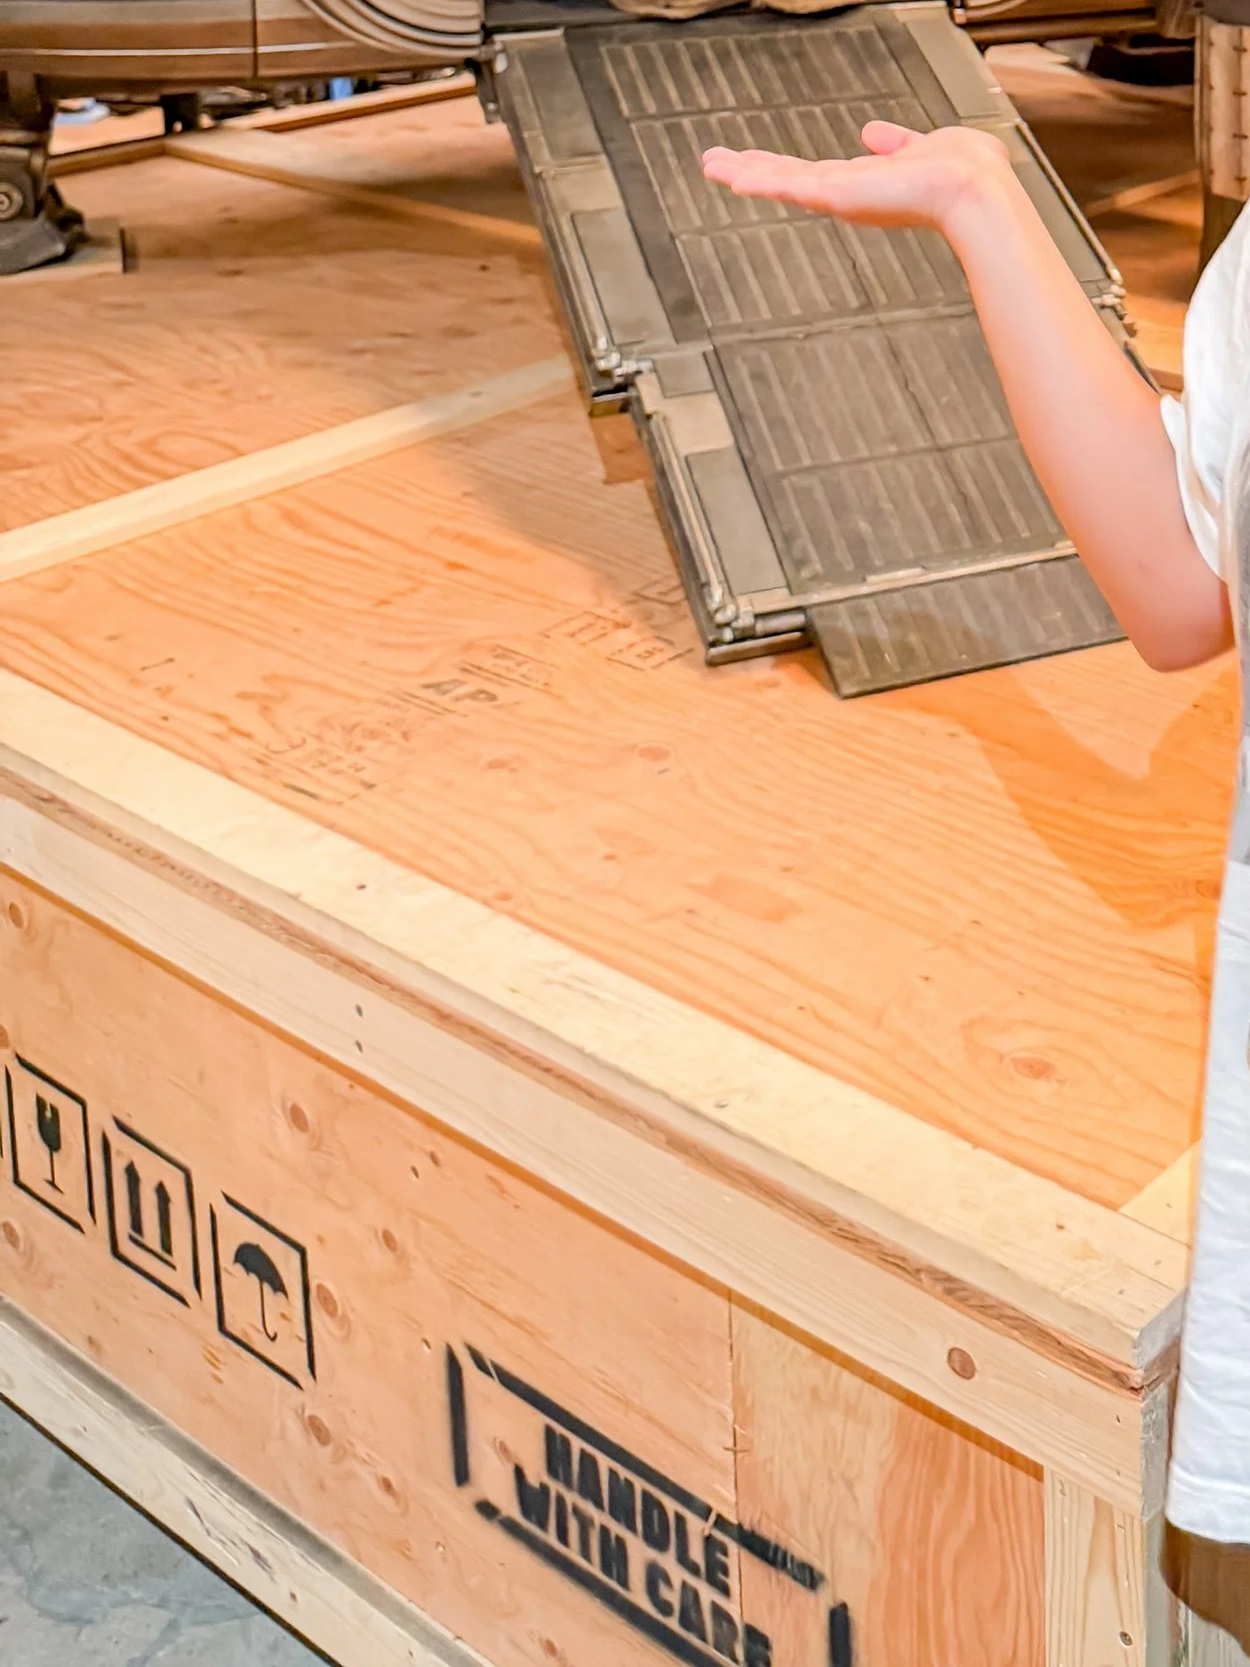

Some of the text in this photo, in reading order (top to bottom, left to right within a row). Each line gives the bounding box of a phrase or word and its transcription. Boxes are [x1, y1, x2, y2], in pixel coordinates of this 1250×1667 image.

[514, 1463, 772, 1667] WITH CARE
[544, 1423, 731, 1599] HANDLE
